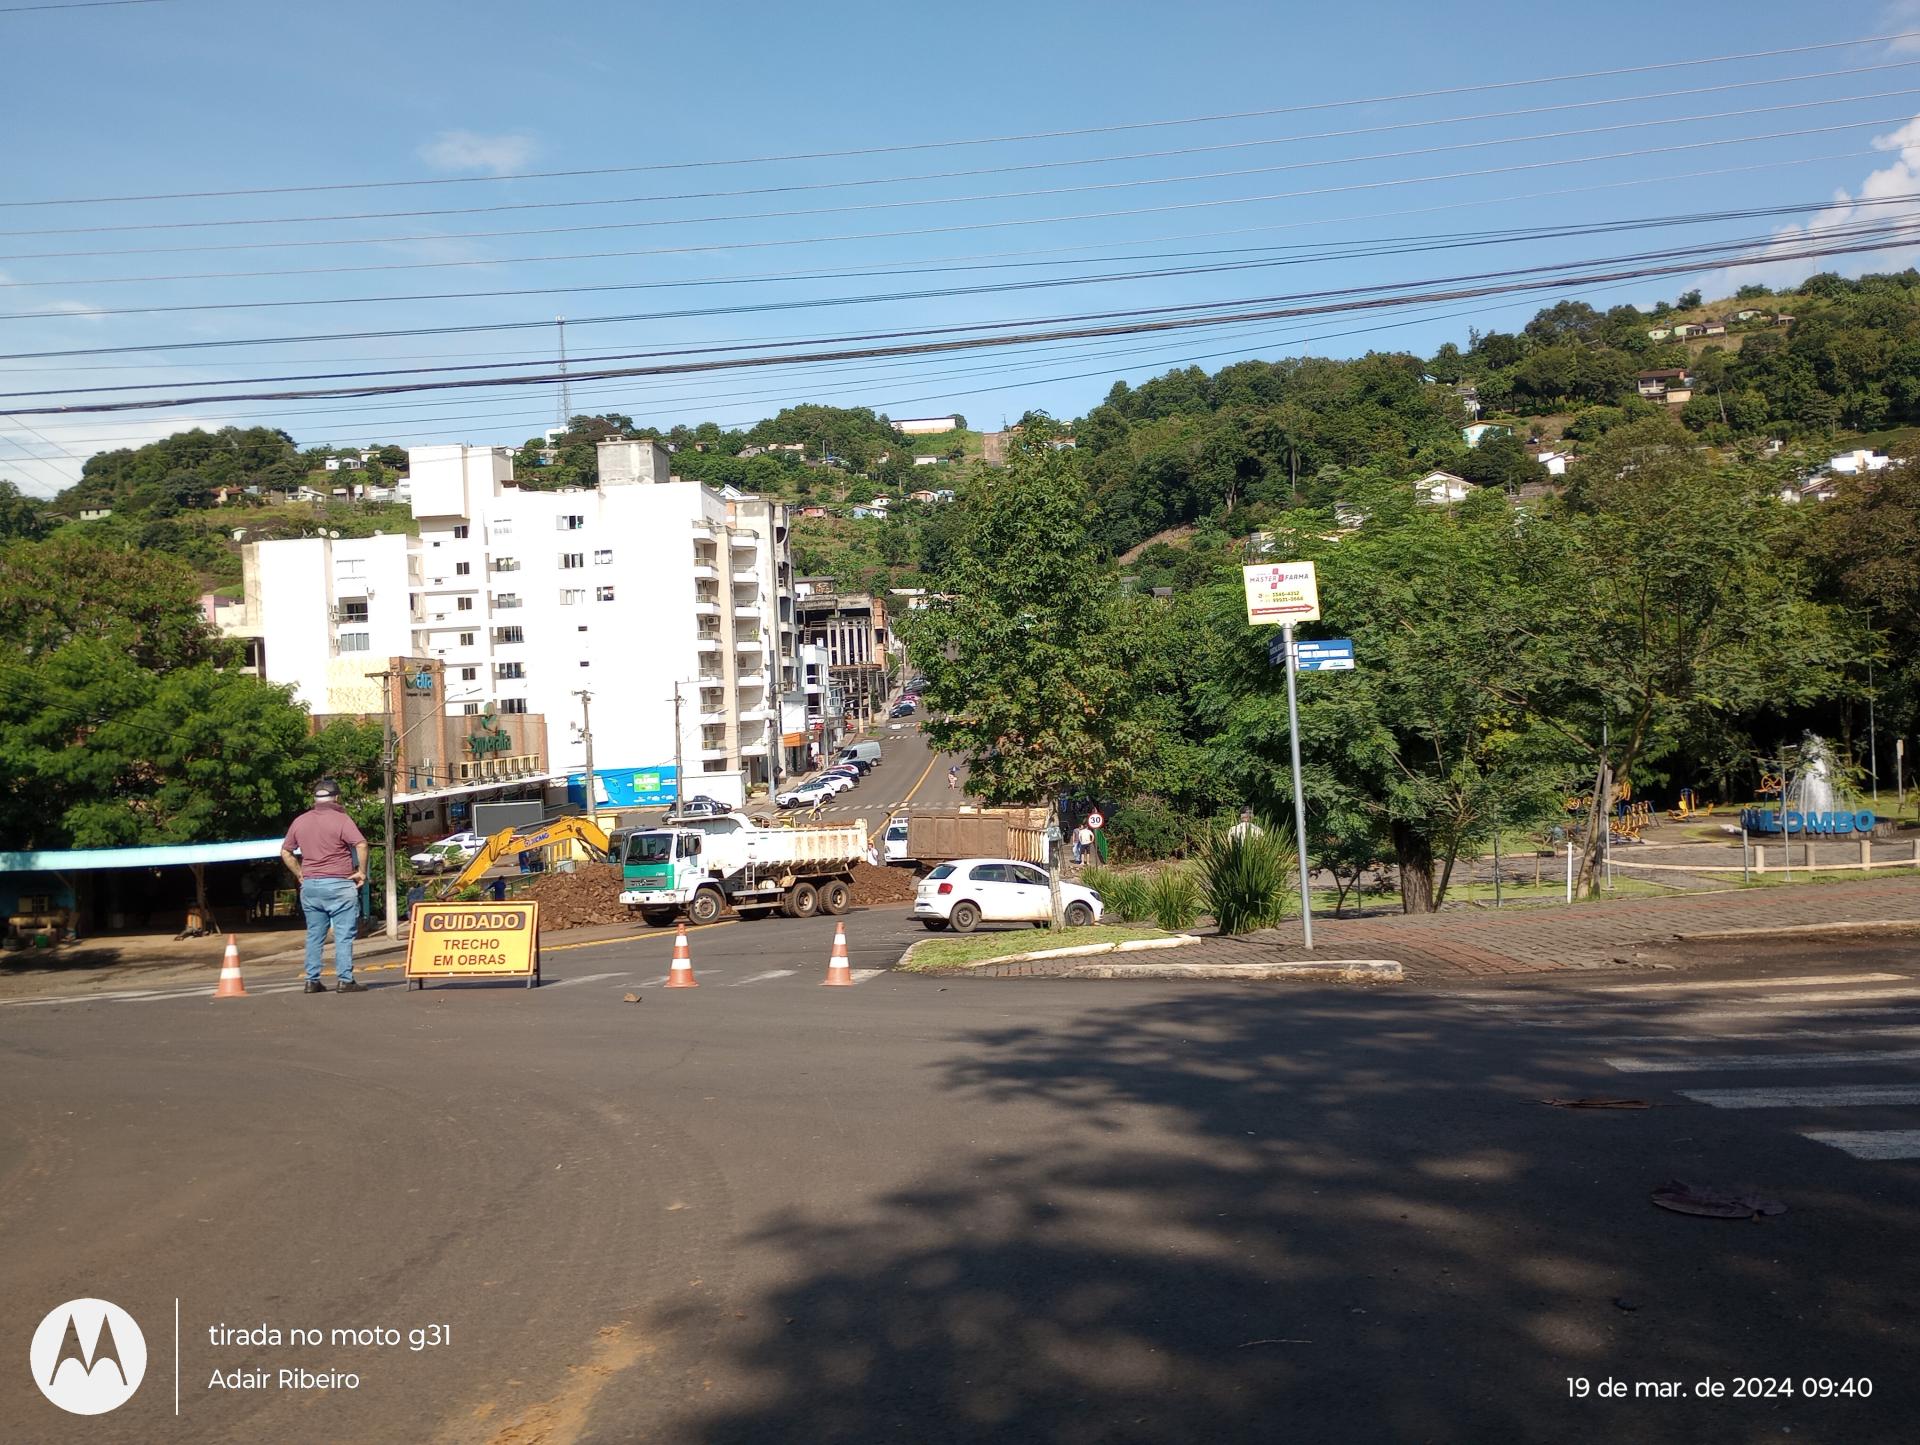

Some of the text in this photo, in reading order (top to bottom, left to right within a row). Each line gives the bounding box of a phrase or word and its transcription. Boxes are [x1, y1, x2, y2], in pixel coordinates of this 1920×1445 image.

[1249, 575, 1277, 583] MASTER
[1090, 816, 1101, 824] 30
[430, 913, 519, 930] CUIDADO
[443, 939, 500, 950] TRECHO
[433, 954, 506, 966] EM OBRAS
